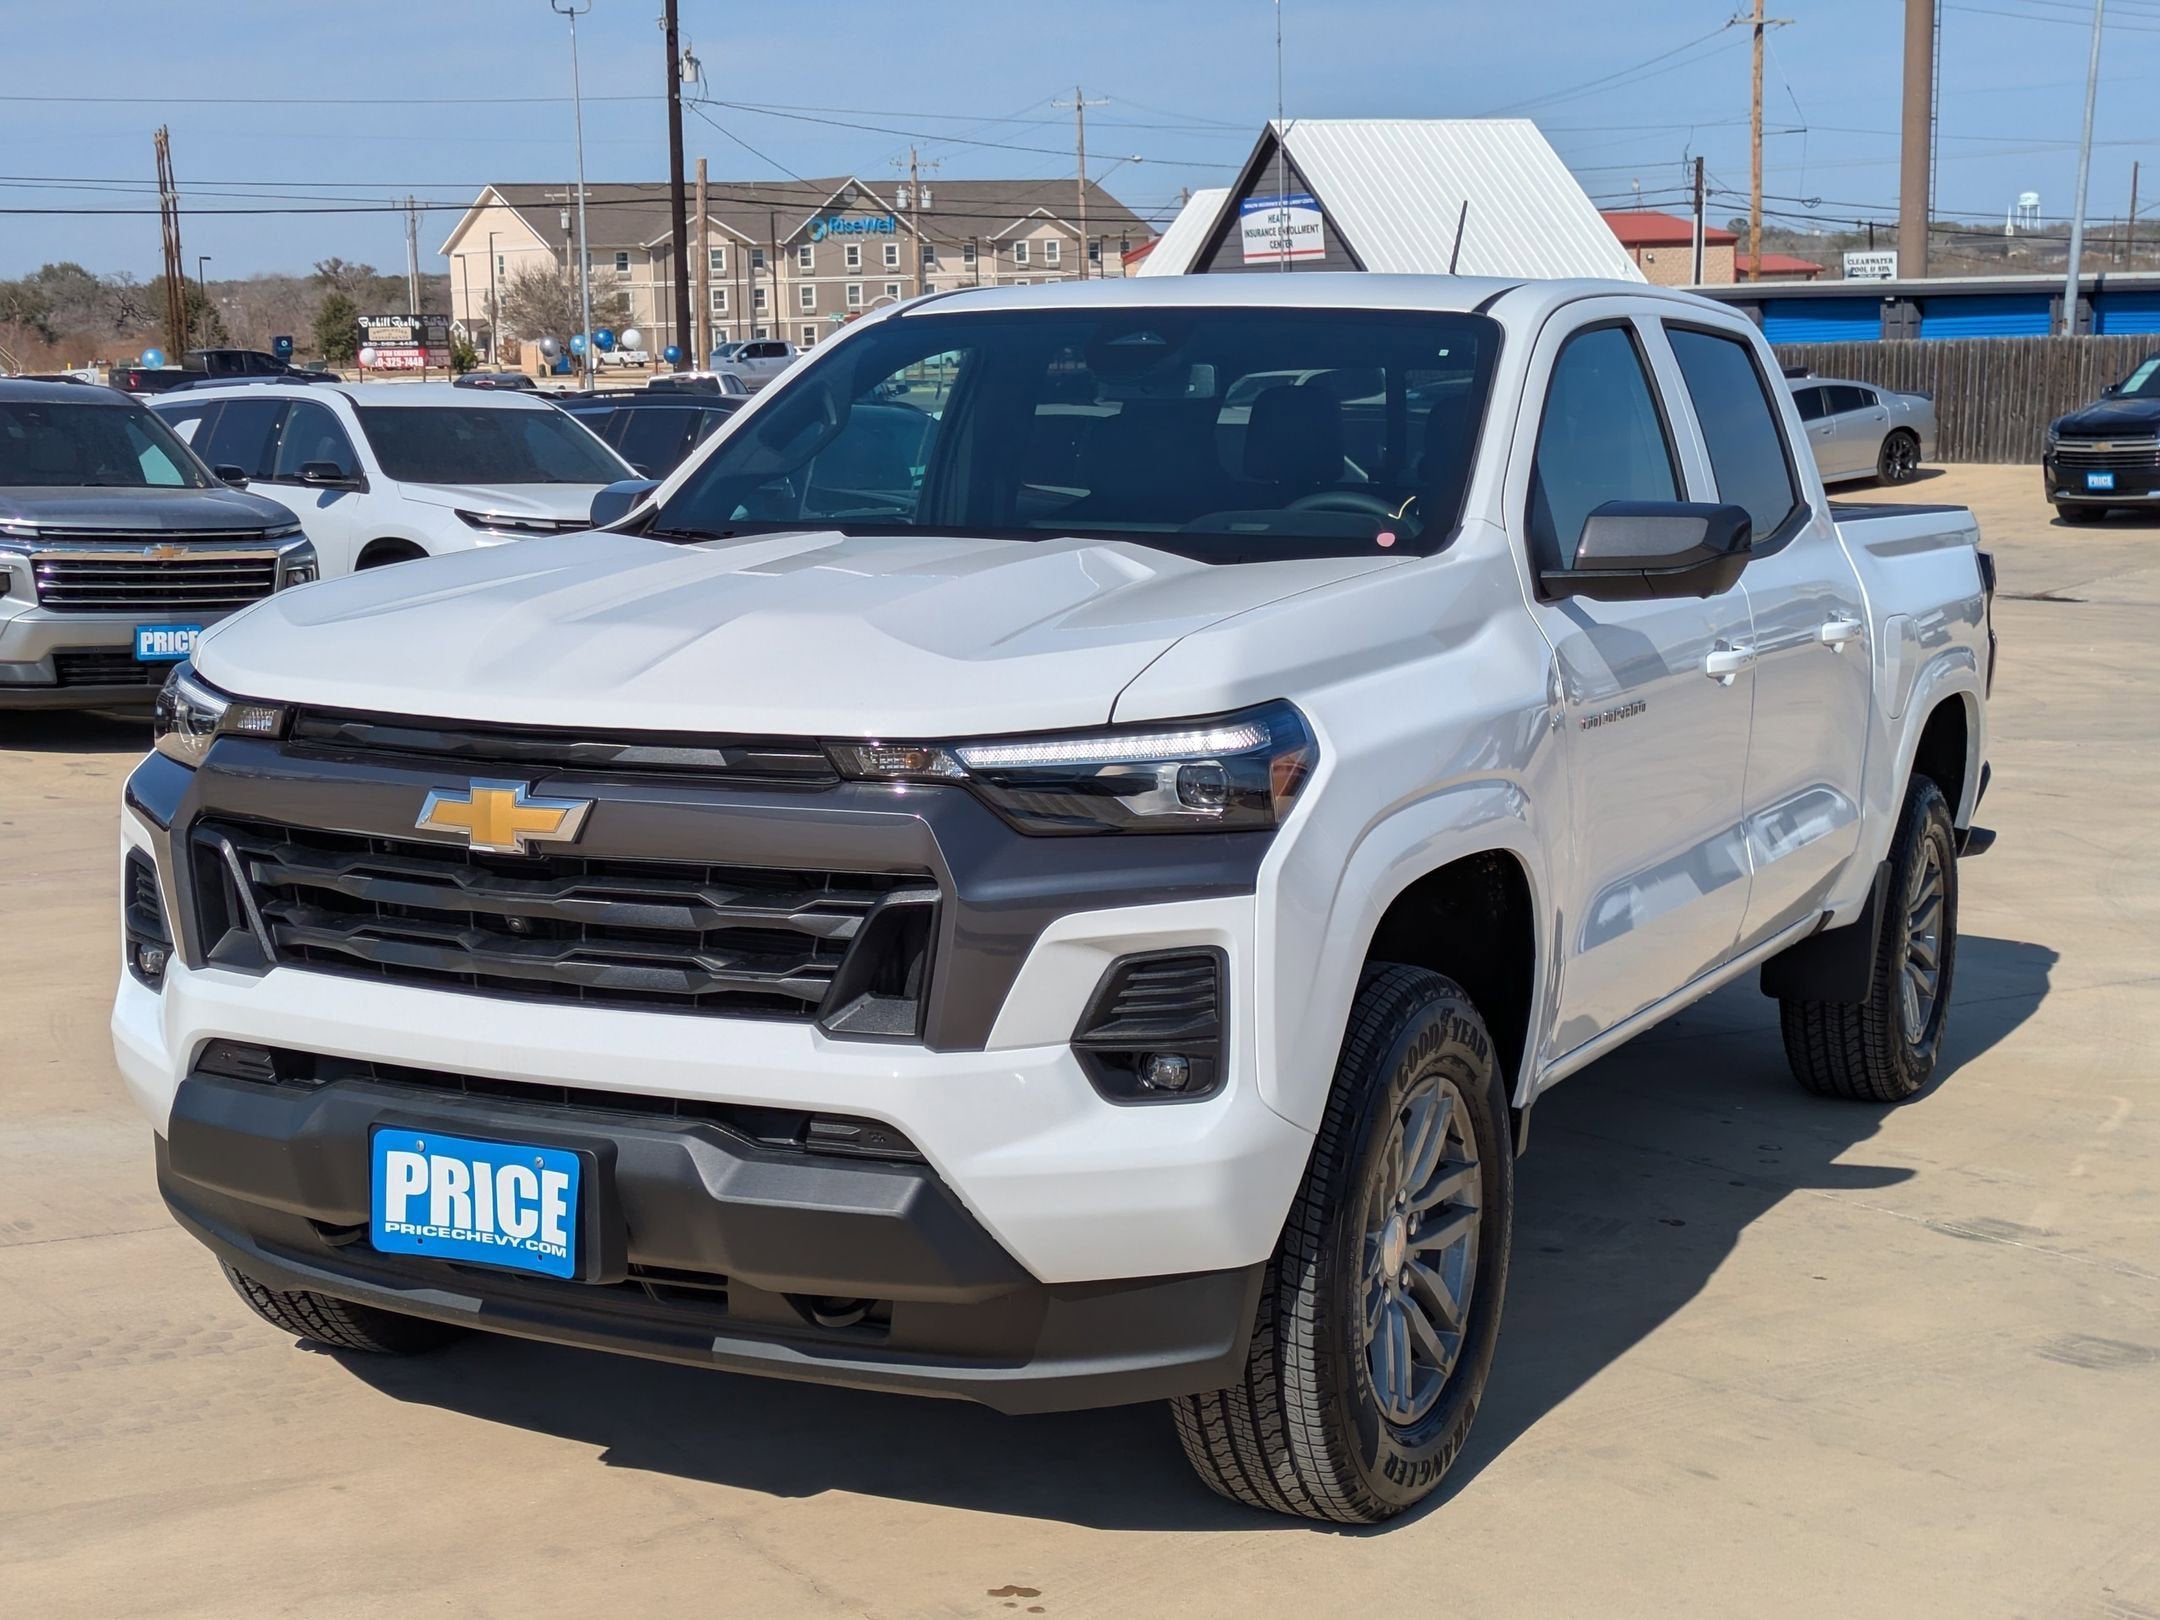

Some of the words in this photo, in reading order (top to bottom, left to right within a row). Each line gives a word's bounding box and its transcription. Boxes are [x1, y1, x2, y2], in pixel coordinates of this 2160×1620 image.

[829, 215, 896, 235] RiseWell
[1245, 227, 1276, 238] INSURANCE
[1848, 257, 1893, 266] CLEARWATER
[385, 1151, 569, 1247] PRICE
[385, 1222, 567, 1259] PRICECHEVY.COM
